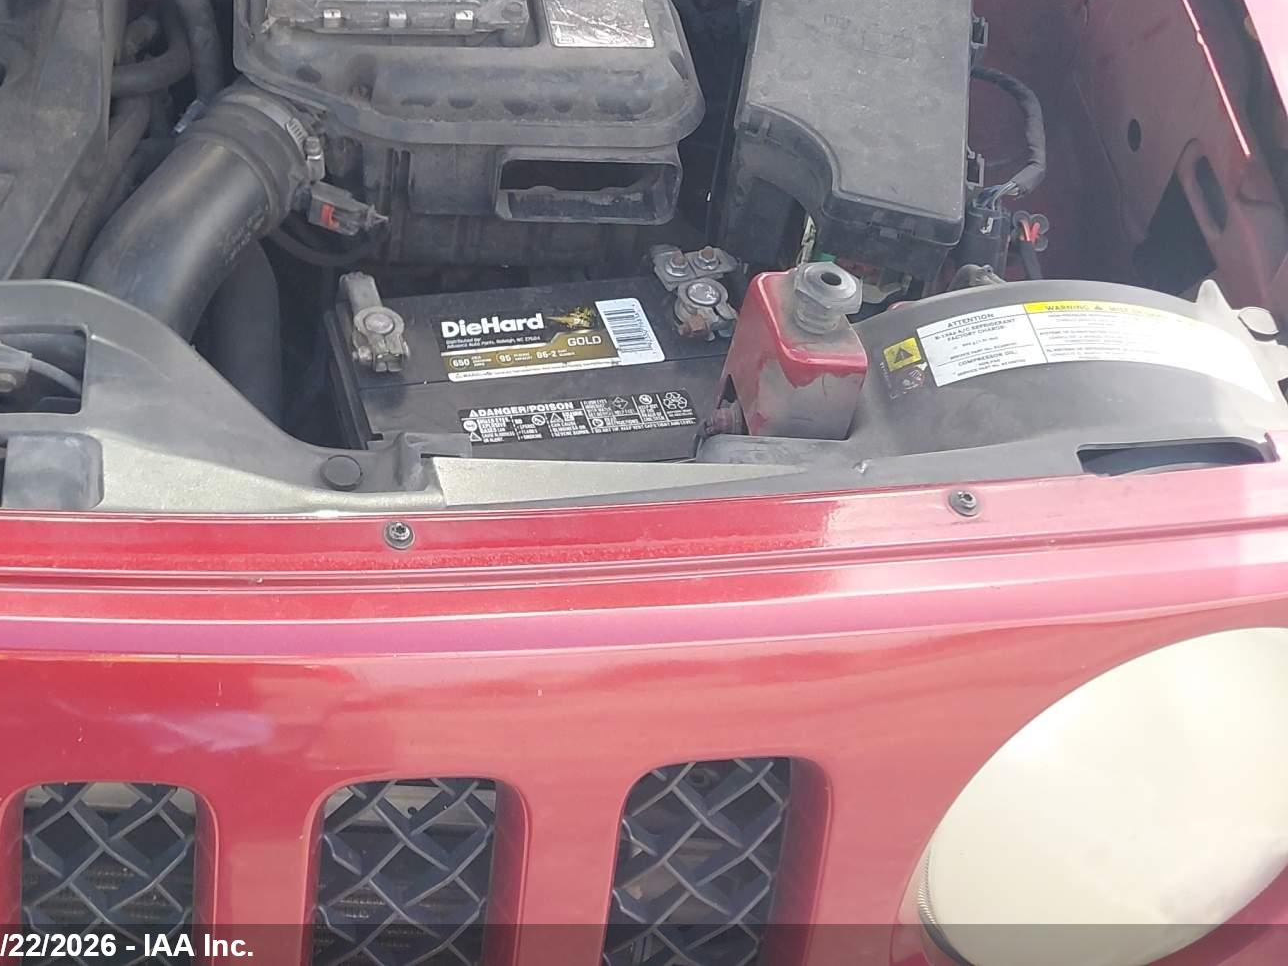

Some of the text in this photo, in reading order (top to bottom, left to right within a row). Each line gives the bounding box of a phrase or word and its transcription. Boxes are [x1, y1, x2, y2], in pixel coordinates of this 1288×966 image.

[440, 312, 545, 338] DieHard
[947, 313, 995, 329] ATTENTION
[567, 335, 602, 347] GOLD
[452, 358, 470, 368] 650
[477, 401, 574, 418] DANGER/POISON
